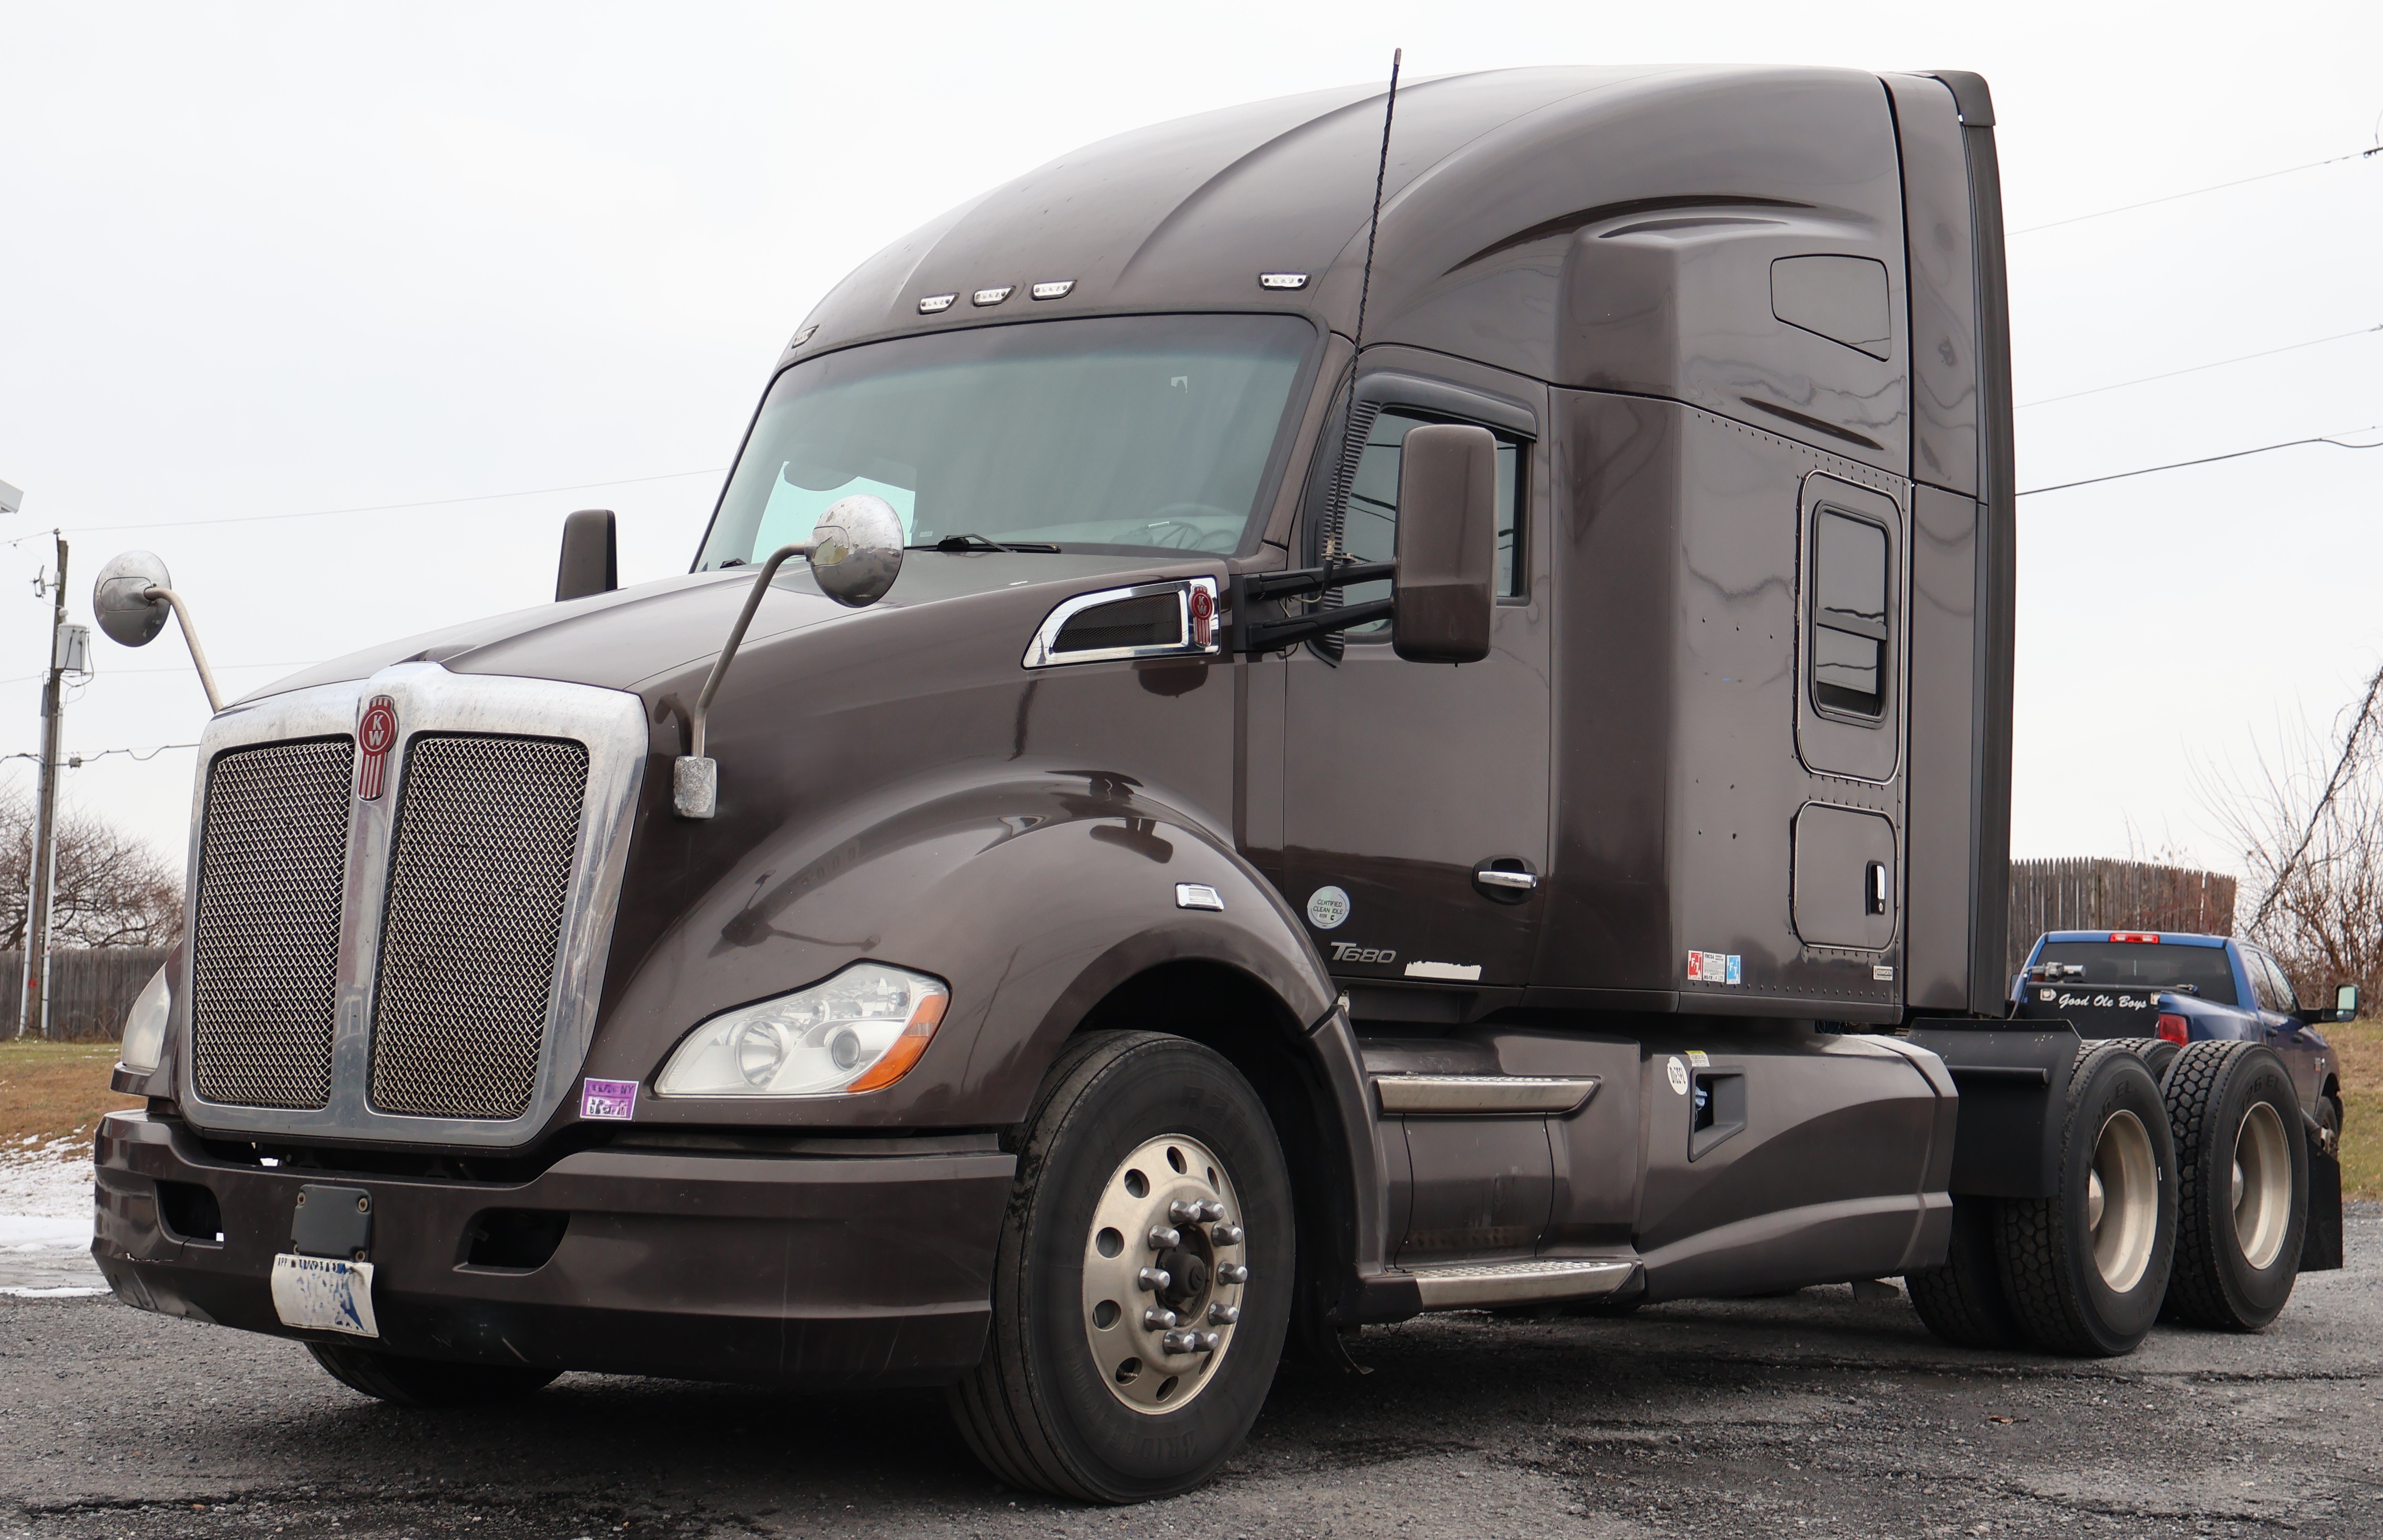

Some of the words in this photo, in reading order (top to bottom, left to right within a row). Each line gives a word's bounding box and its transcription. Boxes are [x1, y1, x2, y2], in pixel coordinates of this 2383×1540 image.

[1317, 899, 1342, 908] CERTIFIED
[1330, 941, 1396, 963] T680
[2059, 993, 2090, 1009] Good
[2093, 994, 2114, 1007] Ole
[2118, 995, 2148, 1011] Boys
[1669, 1067, 1686, 1084] DIESEL
